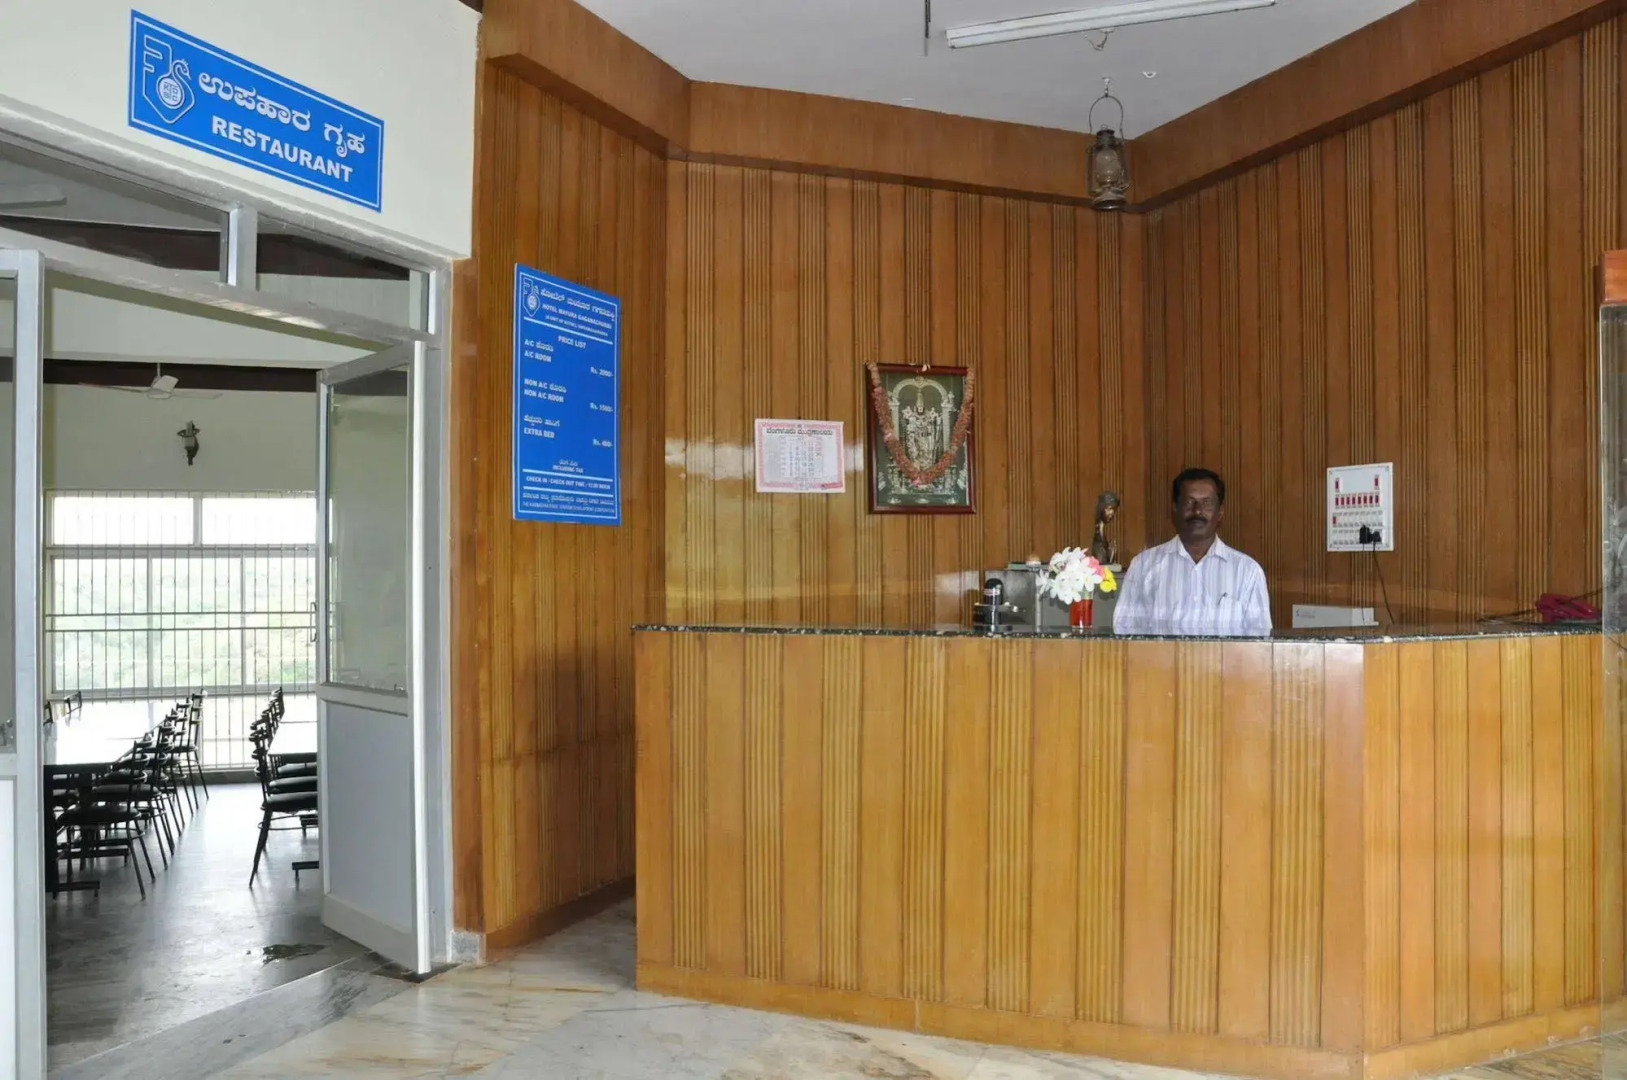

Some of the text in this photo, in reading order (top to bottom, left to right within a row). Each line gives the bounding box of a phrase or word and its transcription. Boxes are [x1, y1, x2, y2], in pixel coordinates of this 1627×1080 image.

[198, 72, 365, 158] ಉಪಹಾರ ಗೃಹ
[211, 115, 353, 183] RESTAURANT
[542, 304, 558, 314] HOTEL
[559, 336, 587, 349] PRICE LIST
[525, 351, 552, 363] A/C ROOM
[525, 379, 538, 388] NON
[524, 390, 537, 398] NON
[548, 394, 564, 403] ROOM
[524, 428, 555, 438] EXTRA BED
